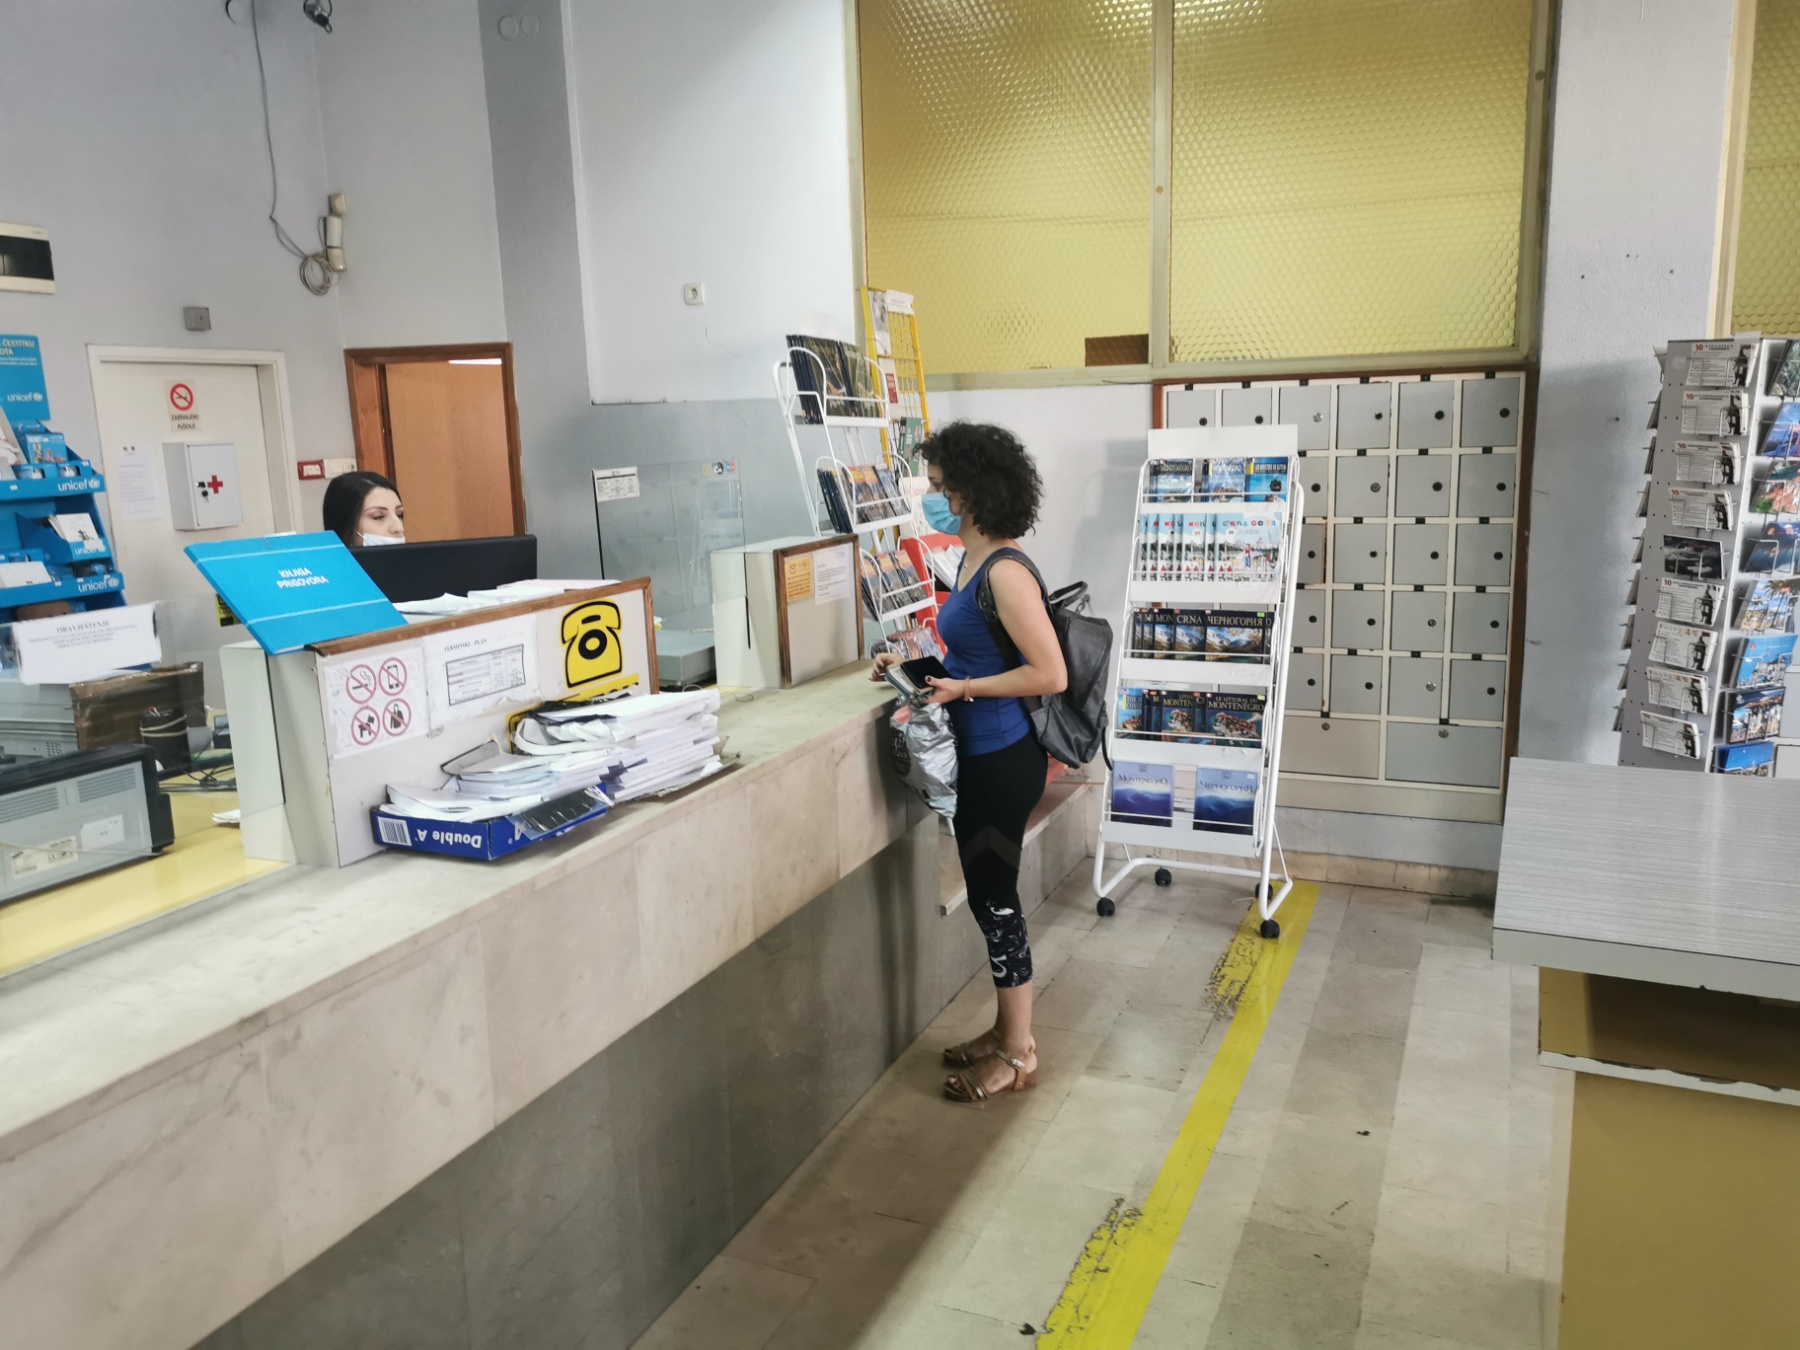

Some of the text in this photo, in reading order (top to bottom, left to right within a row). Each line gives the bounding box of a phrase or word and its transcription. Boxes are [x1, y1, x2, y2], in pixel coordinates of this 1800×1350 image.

[7, 392, 33, 402] unicef
[58, 478, 90, 491] unicef
[278, 566, 313, 578] KNJIGA
[78, 577, 108, 593] unicef
[276, 575, 329, 590] PRIGOVORA
[1176, 614, 1203, 624] CRNA
[1207, 616, 1263, 627] ЧЕРНОГОРИЯ
[432, 829, 482, 849] Double
